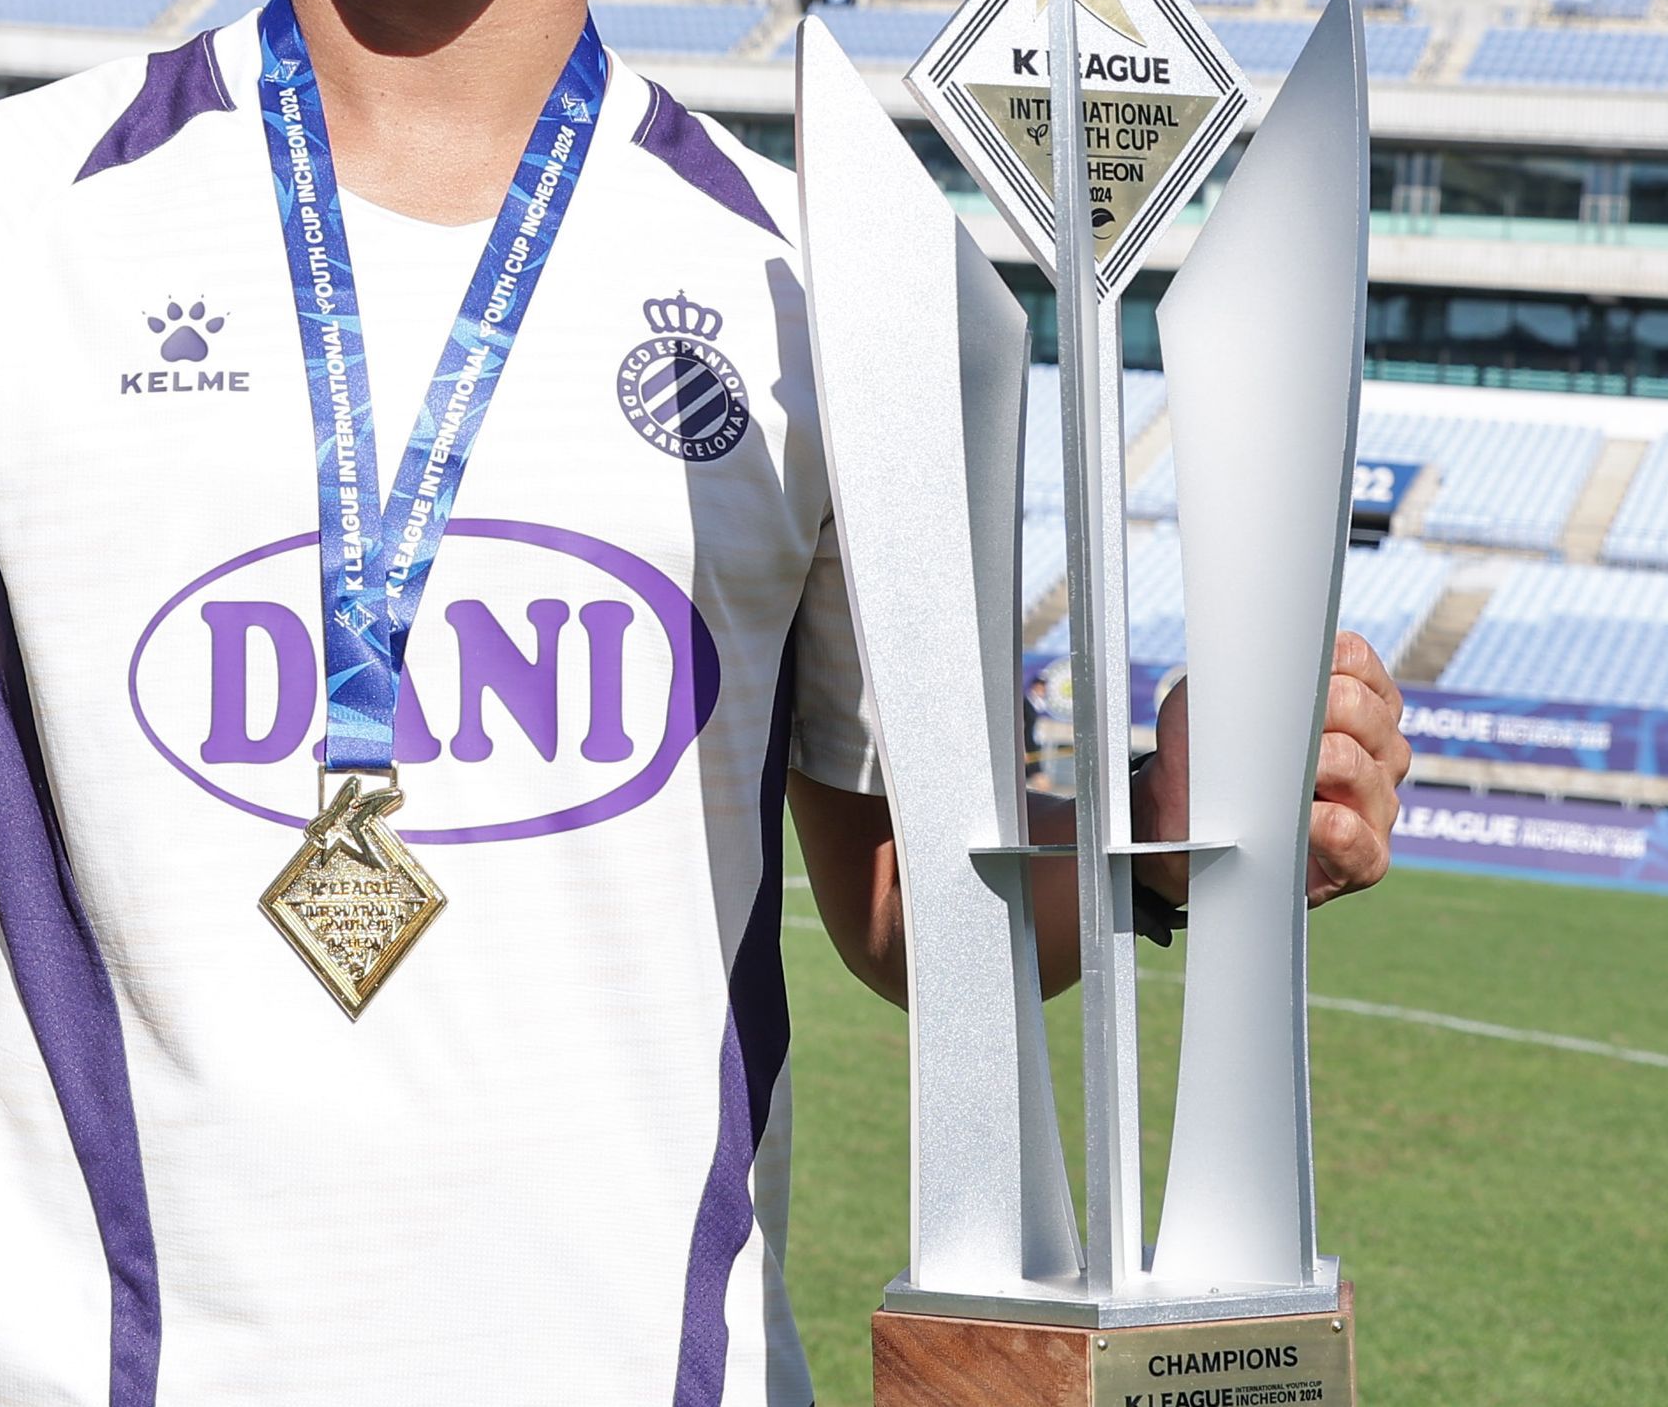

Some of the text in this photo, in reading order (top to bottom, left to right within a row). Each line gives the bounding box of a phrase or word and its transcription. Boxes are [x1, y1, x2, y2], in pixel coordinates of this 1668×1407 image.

[1012, 48, 1170, 84] K AGUE
[1010, 97, 1179, 127] INTATIONAL
[1116, 129, 1158, 151] CUP
[279, 87, 363, 590] K LEAGUE INTERNATIONAL YOUTH CUP INCHEON 2024
[386, 125, 576, 598] K LEAGUE INTERNATIONAL YOUTH CUP INCHEON 2024
[622, 340, 744, 401] RCD ESPANYOL
[121, 371, 249, 394] KELME
[623, 395, 744, 457] DE BARCELONA
[1353, 465, 1394, 503] 22
[1399, 705, 1493, 742] EAGUE
[1149, 1346, 1298, 1377] CHAMPIONS
[1125, 1388, 1323, 1407] K LEAGUE INCHEON 2024
[1235, 1384, 1284, 1393] INTERNATIONAL
[1309, 1380, 1322, 1388] CUP
